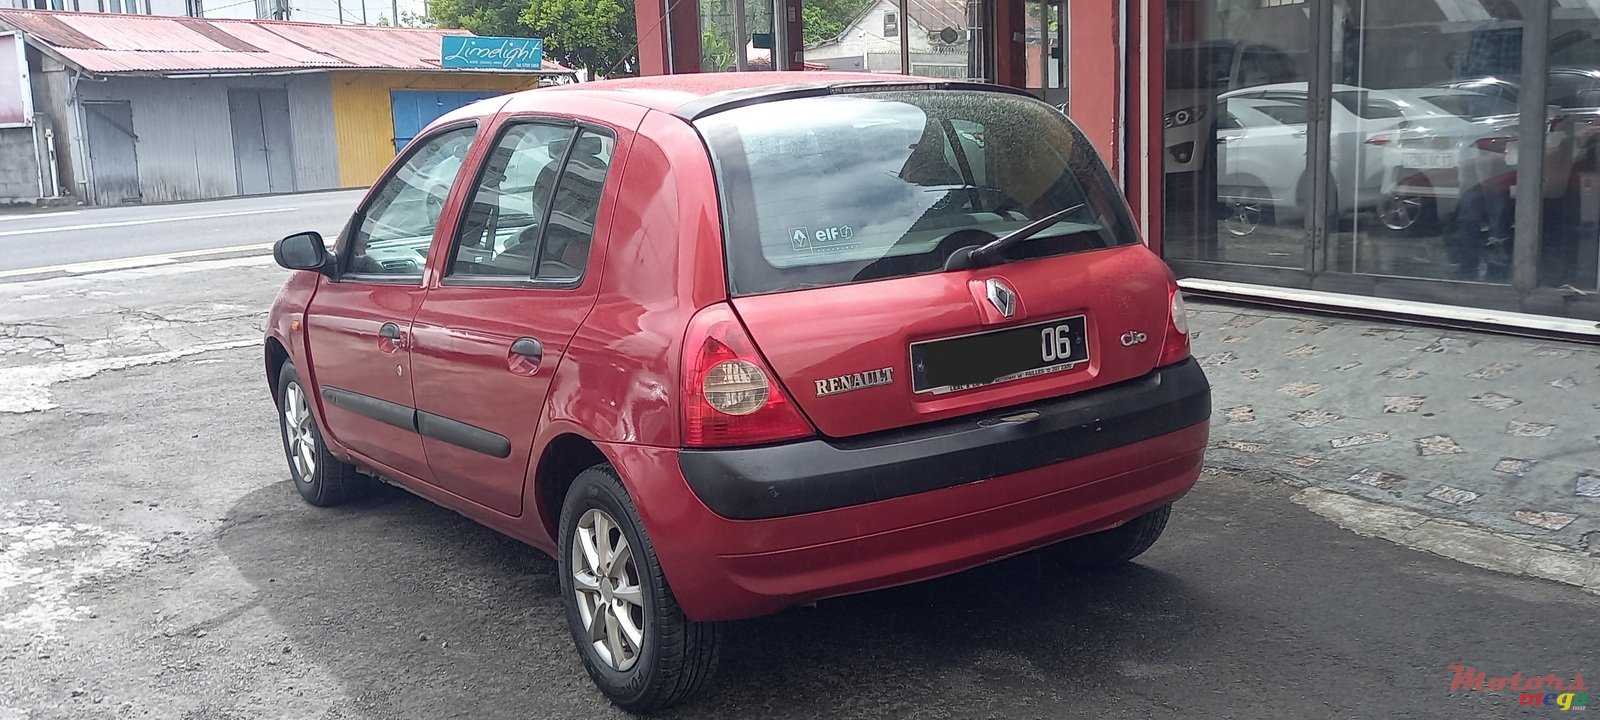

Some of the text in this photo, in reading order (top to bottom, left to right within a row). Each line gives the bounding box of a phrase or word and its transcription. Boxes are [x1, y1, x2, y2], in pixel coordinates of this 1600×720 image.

[445, 38, 540, 67] Limelight
[816, 227, 838, 241] elf
[1041, 324, 1072, 362] 06
[1120, 330, 1147, 346] Clio
[814, 366, 894, 397] RENAULT
